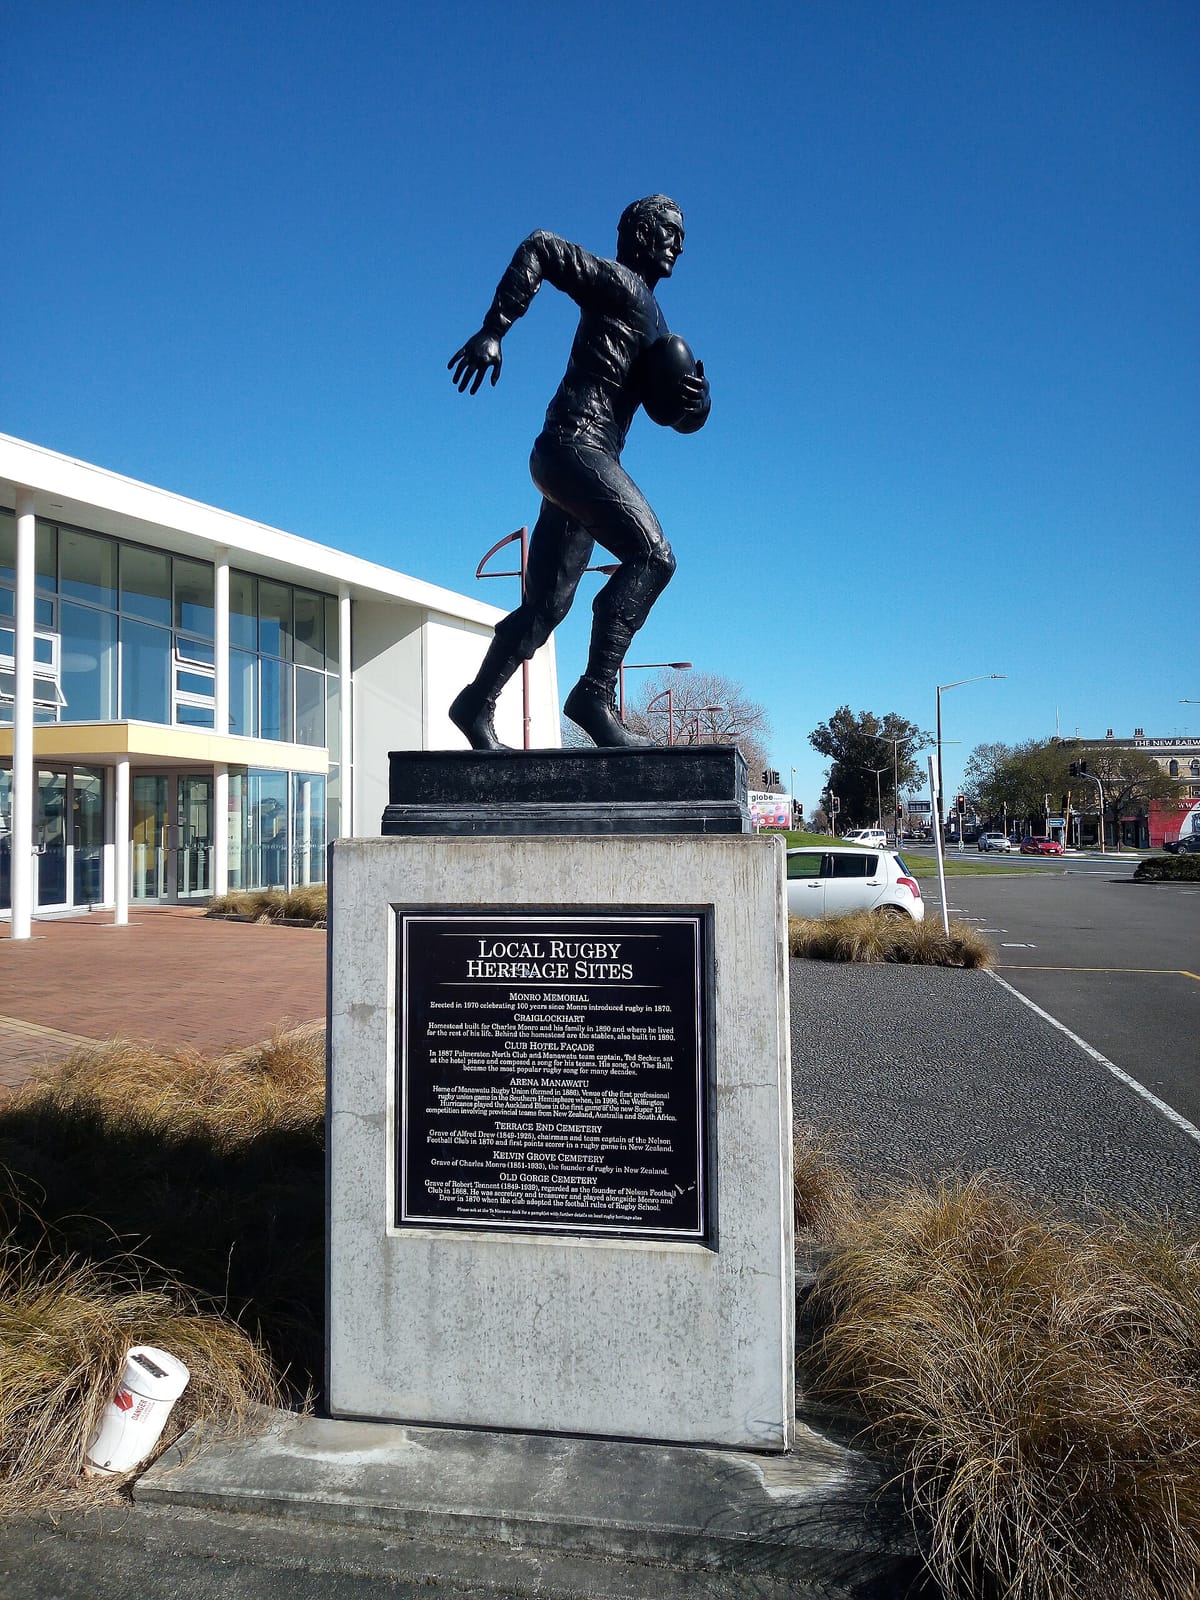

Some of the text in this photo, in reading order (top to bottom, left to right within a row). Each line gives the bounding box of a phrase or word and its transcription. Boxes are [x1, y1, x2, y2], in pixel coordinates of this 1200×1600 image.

[478, 940, 622, 958] LOCAL RUGBY
[466, 960, 633, 980] HERITAGE SITES
[509, 993, 589, 1002] MONRO MEMORIAL
[479, 1002, 515, 1011] celebrating
[624, 1004, 643, 1013] rugby
[513, 1014, 585, 1022] CRAIGLOCKHART
[564, 1025, 585, 1033] family
[590, 1032, 616, 1040] stables,
[504, 1041, 595, 1053] CLUB HOTEL FAÇADE
[467, 1057, 484, 1066] piano
[499, 1058, 530, 1067] composed
[509, 1078, 589, 1087] ARENA MANAWATU
[495, 1121, 603, 1133] TERRACE END CEMETERY
[523, 1140, 543, 1148] points
[580, 1142, 599, 1150] rugby
[493, 1151, 605, 1163] KELVIN GROVE CEMETERY
[594, 1165, 613, 1174] rugby
[499, 1173, 598, 1184] OLD GORGE CEMETERY
[494, 1190, 523, 1199] secretary
[583, 1193, 604, 1202] played
[605, 1194, 636, 1204] alongside
[526, 1198, 551, 1207] adopted
[615, 1202, 636, 1211] Rugby
[131, 1400, 148, 1420] DANGER
